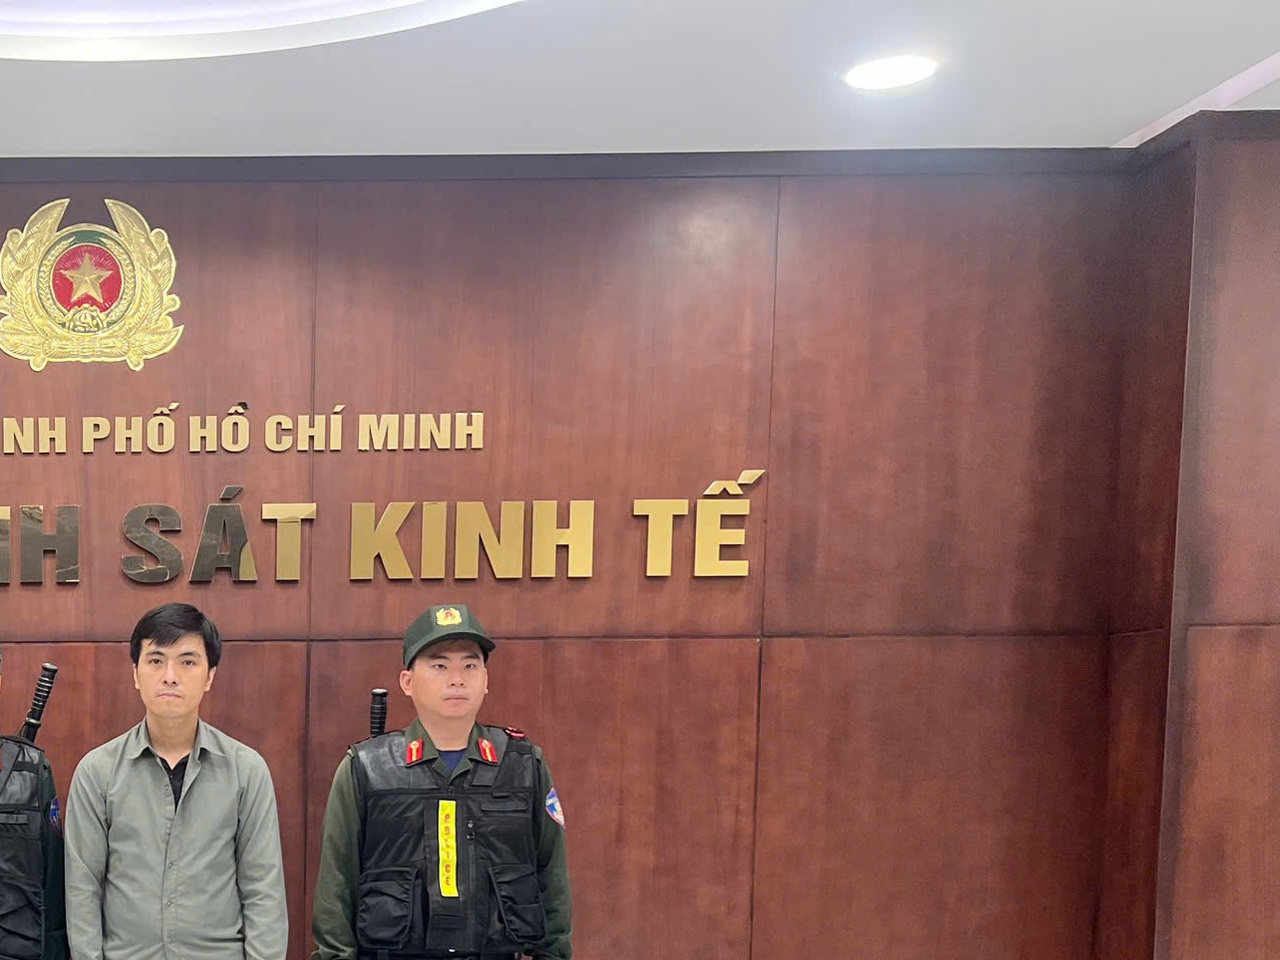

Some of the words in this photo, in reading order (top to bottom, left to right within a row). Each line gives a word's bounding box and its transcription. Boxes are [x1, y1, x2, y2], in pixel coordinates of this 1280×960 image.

[82, 402, 180, 453] PHỐ
[189, 402, 249, 453] HỒ
[265, 405, 346, 452] CHÍ
[357, 412, 484, 451] MINH
[121, 486, 317, 583] SÁT
[350, 500, 595, 580] KINH
[633, 470, 766, 578] TẾ
